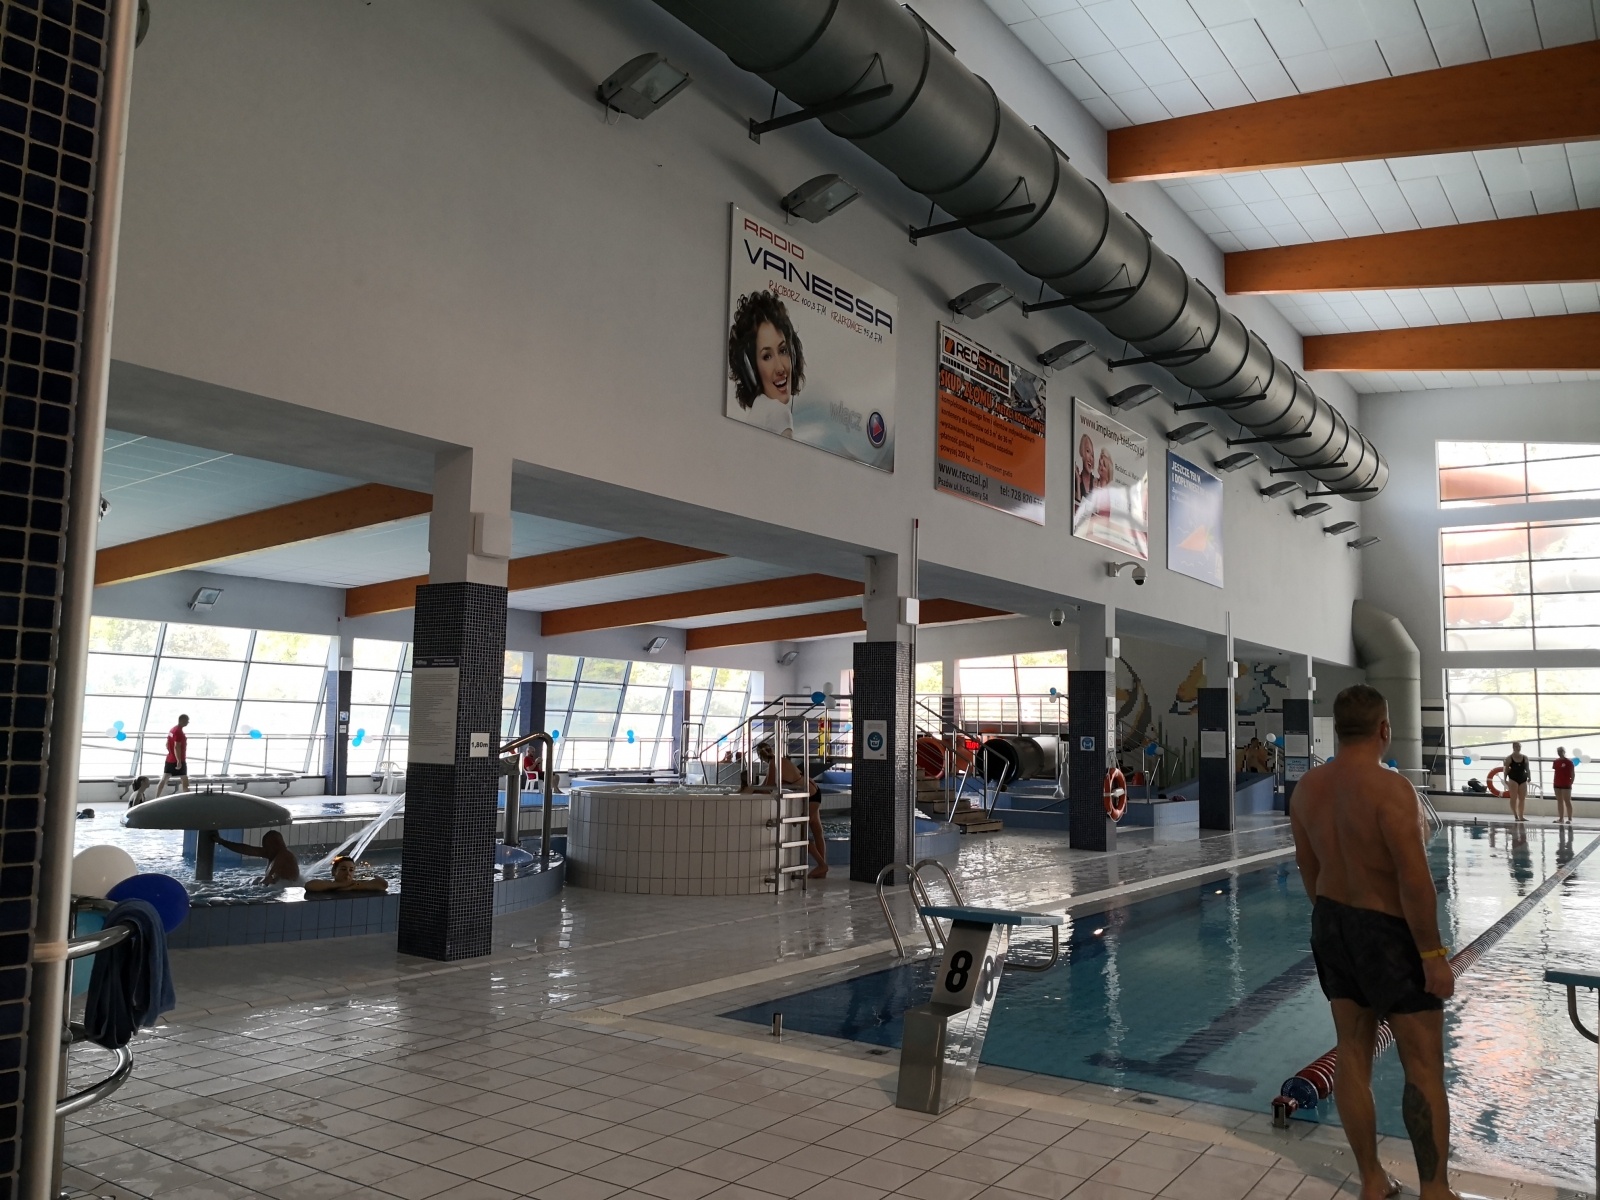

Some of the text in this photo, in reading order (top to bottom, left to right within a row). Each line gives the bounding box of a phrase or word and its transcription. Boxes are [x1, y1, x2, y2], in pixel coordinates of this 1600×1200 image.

[744, 217, 804, 260] RADIO
[743, 238, 893, 335] VANESSA
[816, 303, 827, 317] FM
[874, 332, 883, 344] FM
[956, 341, 1009, 383] RECSTAL
[940, 369, 961, 392] SKUP
[964, 382, 992, 409] ZŁOMU
[938, 462, 989, 490] www.recstal.pl
[938, 476, 953, 489] Pszów
[1171, 460, 1191, 479] JESZCZE
[1000, 485, 1010, 498] tel:
[1010, 488, 1022, 502] 728
[471, 741, 488, 749] 1,80m
[944, 949, 973, 993] 8
[983, 955, 995, 1002] 8
